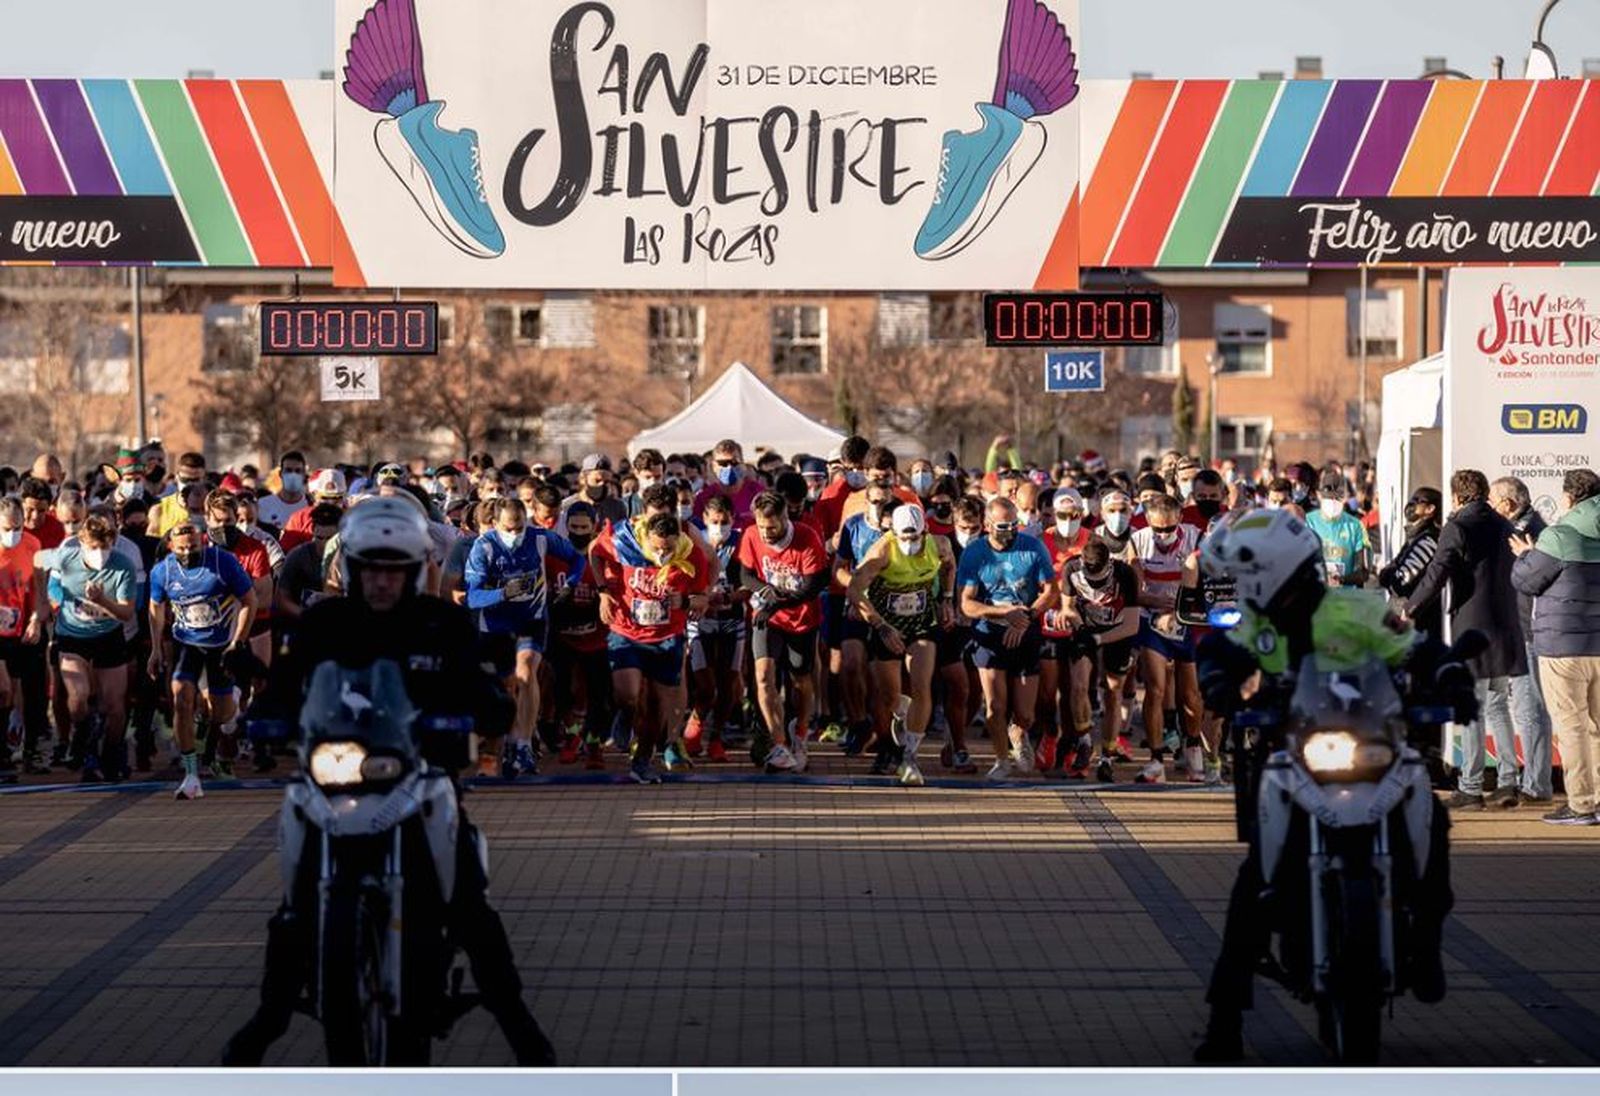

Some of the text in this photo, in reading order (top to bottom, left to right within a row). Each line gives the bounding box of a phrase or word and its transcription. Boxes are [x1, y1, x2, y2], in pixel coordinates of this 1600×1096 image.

[717, 64, 938, 87] 31 DE DICIEMBRE
[11, 220, 121, 252] nuevo
[624, 207, 778, 265] LAS ROZAS
[1298, 199, 1598, 266] Feliz año nuevo
[270, 309, 426, 348] 00:00:00
[995, 301, 1151, 339] 00:00:00
[1052, 361, 1096, 381] 10K
[1521, 352, 1600, 365] Santander
[335, 365, 366, 389] 5K
[1537, 408, 1579, 429] BM
